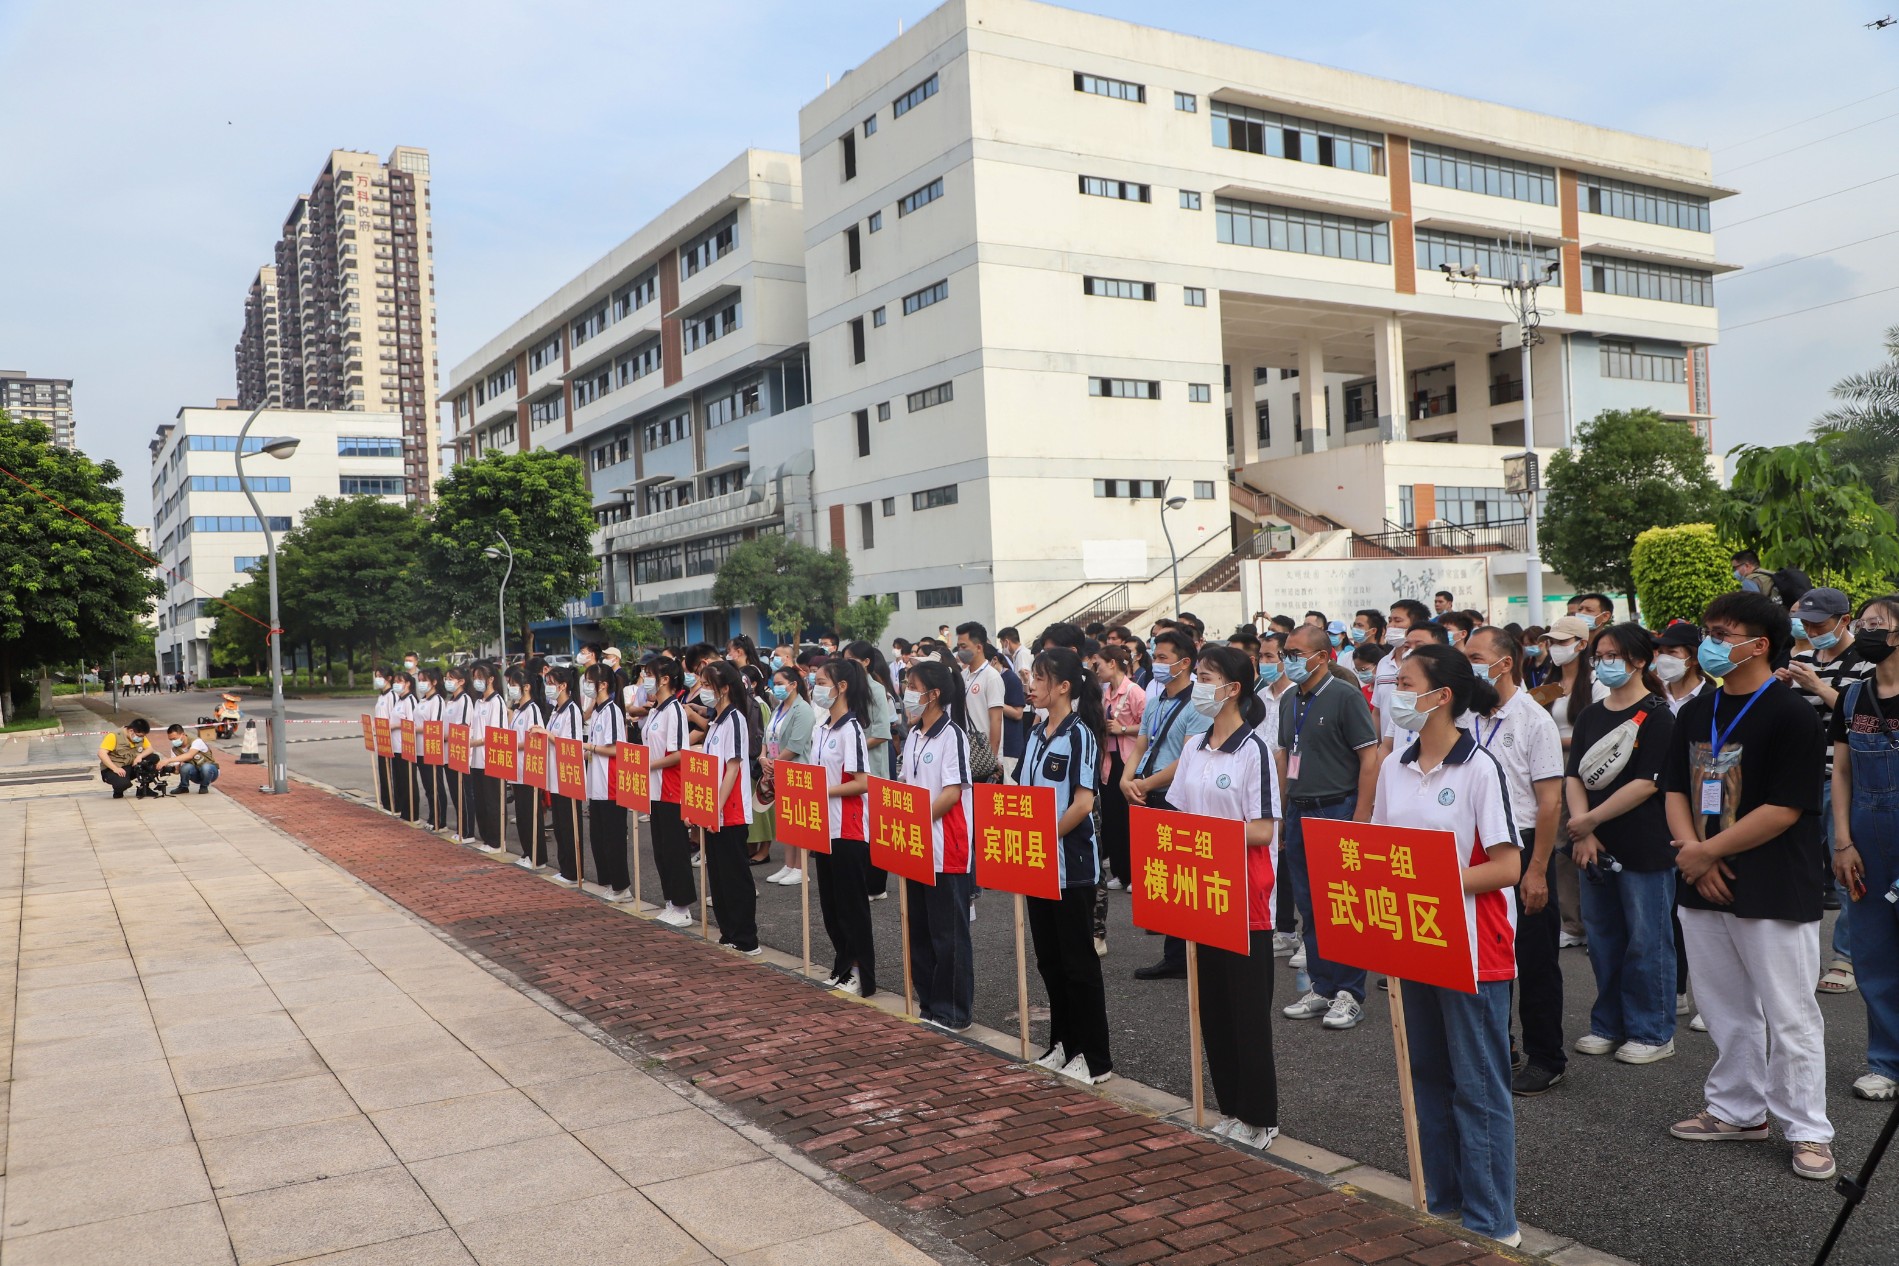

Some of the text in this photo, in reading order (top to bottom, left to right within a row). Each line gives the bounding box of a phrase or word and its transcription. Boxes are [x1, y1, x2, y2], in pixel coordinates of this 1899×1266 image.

[356, 175, 371, 232] 万科悦府
[1391, 568, 1435, 600] 中国梦
[425, 739, 441, 755] 青秀区
[451, 727, 466, 741] 第十一组
[492, 731, 509, 746] 第十组
[529, 736, 542, 750] 第九组
[450, 743, 467, 763] 兴宁区
[488, 747, 514, 768] 江南区
[561, 742, 576, 758] 第八组
[623, 748, 641, 765] 第七组
[525, 753, 544, 775] 良庆区
[559, 762, 582, 786] 邕宁区
[689, 756, 709, 777] 第六组
[1587, 752, 1621, 785] SUBTLE
[618, 769, 648, 797] 西乡塘区
[786, 767, 813, 791] 第五组
[684, 781, 715, 813] 隆安县
[881, 785, 914, 814] 第四组
[993, 792, 1034, 819] 第三组
[781, 795, 823, 832] 马山县
[876, 815, 925, 859] 上林县
[983, 825, 1047, 870] 宾阳县
[1156, 823, 1214, 860] 第二组
[1338, 837, 1417, 880] 第一组
[1143, 856, 1232, 916] 横州市
[1327, 879, 1448, 948] 武鸣区
